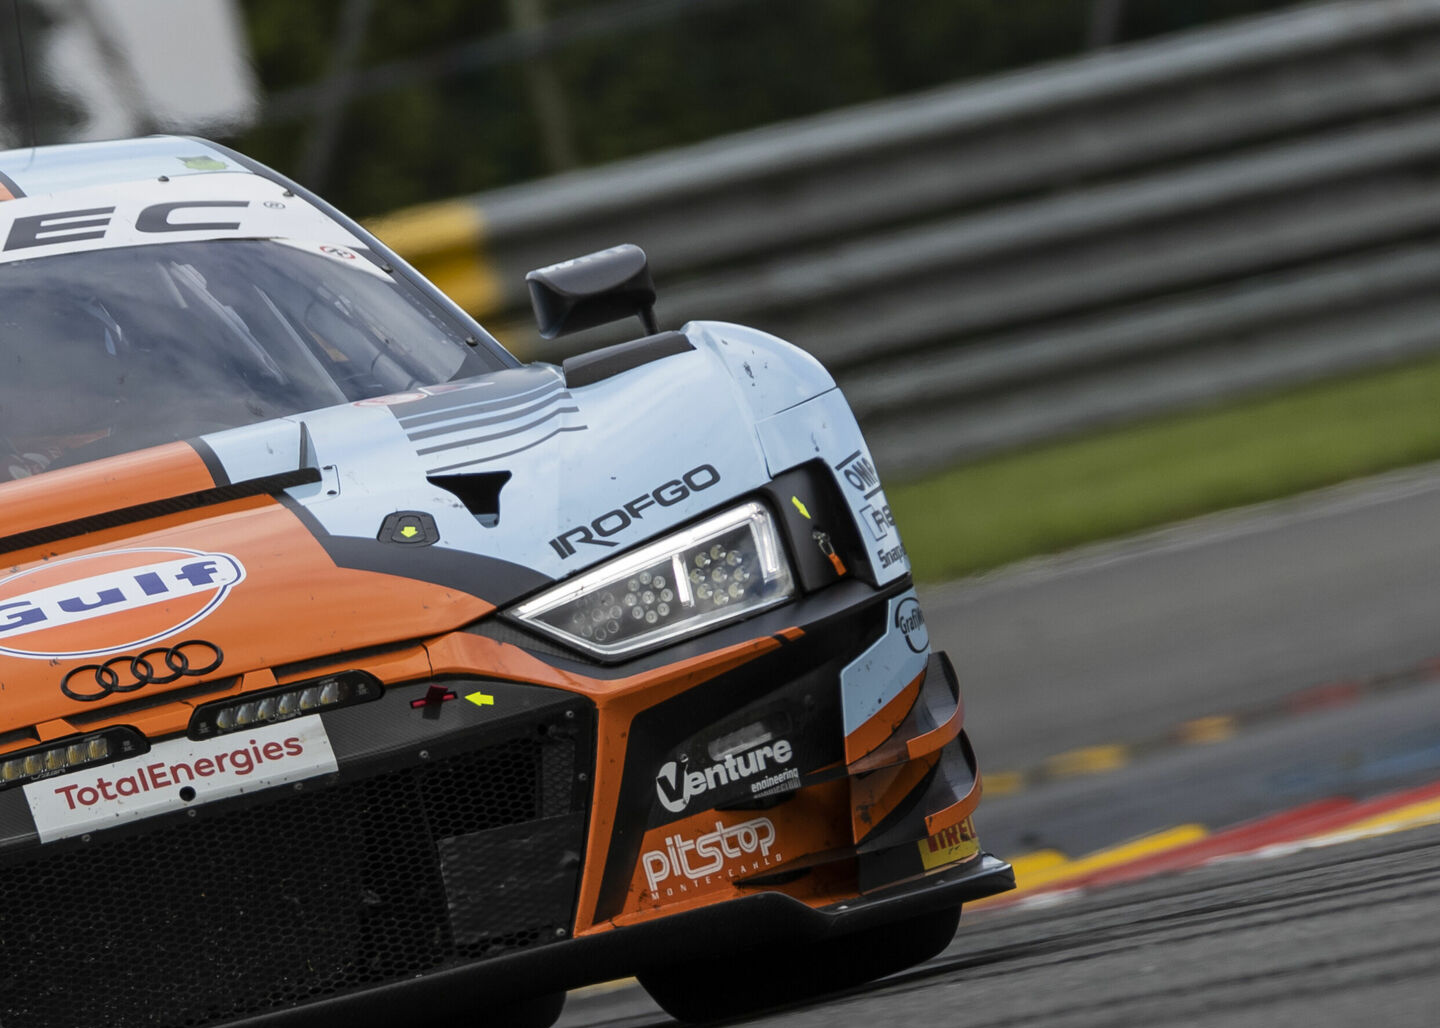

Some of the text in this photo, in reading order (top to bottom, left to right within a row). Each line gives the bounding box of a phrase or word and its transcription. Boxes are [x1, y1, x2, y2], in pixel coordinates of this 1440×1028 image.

[55, 736, 303, 810] TotalEnergies
[656, 739, 793, 813] Venture
[642, 816, 776, 892] pitstop
[651, 853, 783, 901] MONTE-CARLO
